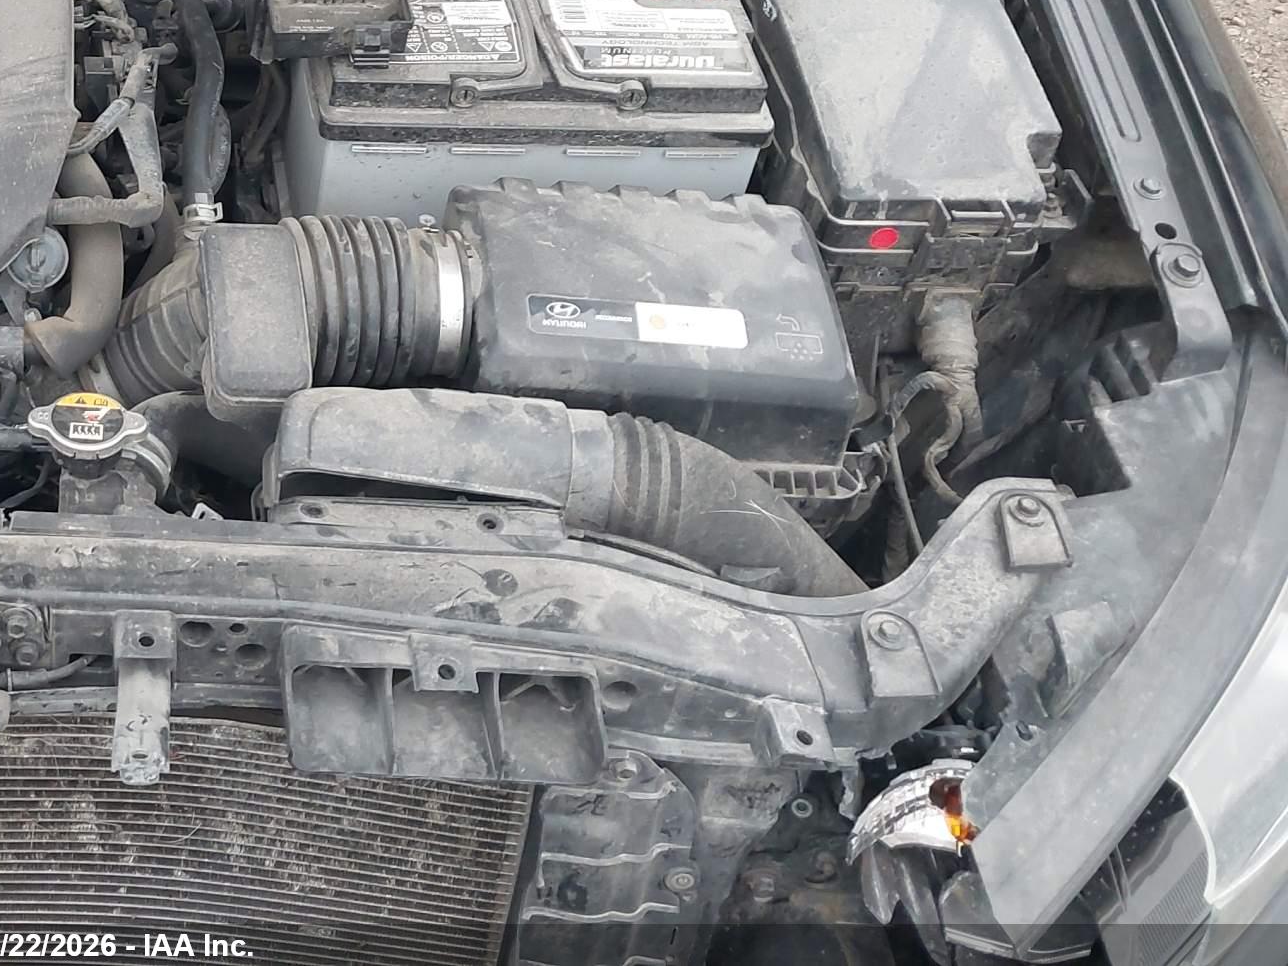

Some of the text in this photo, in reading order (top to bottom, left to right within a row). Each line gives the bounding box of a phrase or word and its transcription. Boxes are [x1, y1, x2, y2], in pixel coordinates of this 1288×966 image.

[601, 39, 679, 47] TECHNOLOGY
[600, 53, 723, 70] Duralast
[542, 318, 588, 330] HYUNDAI
